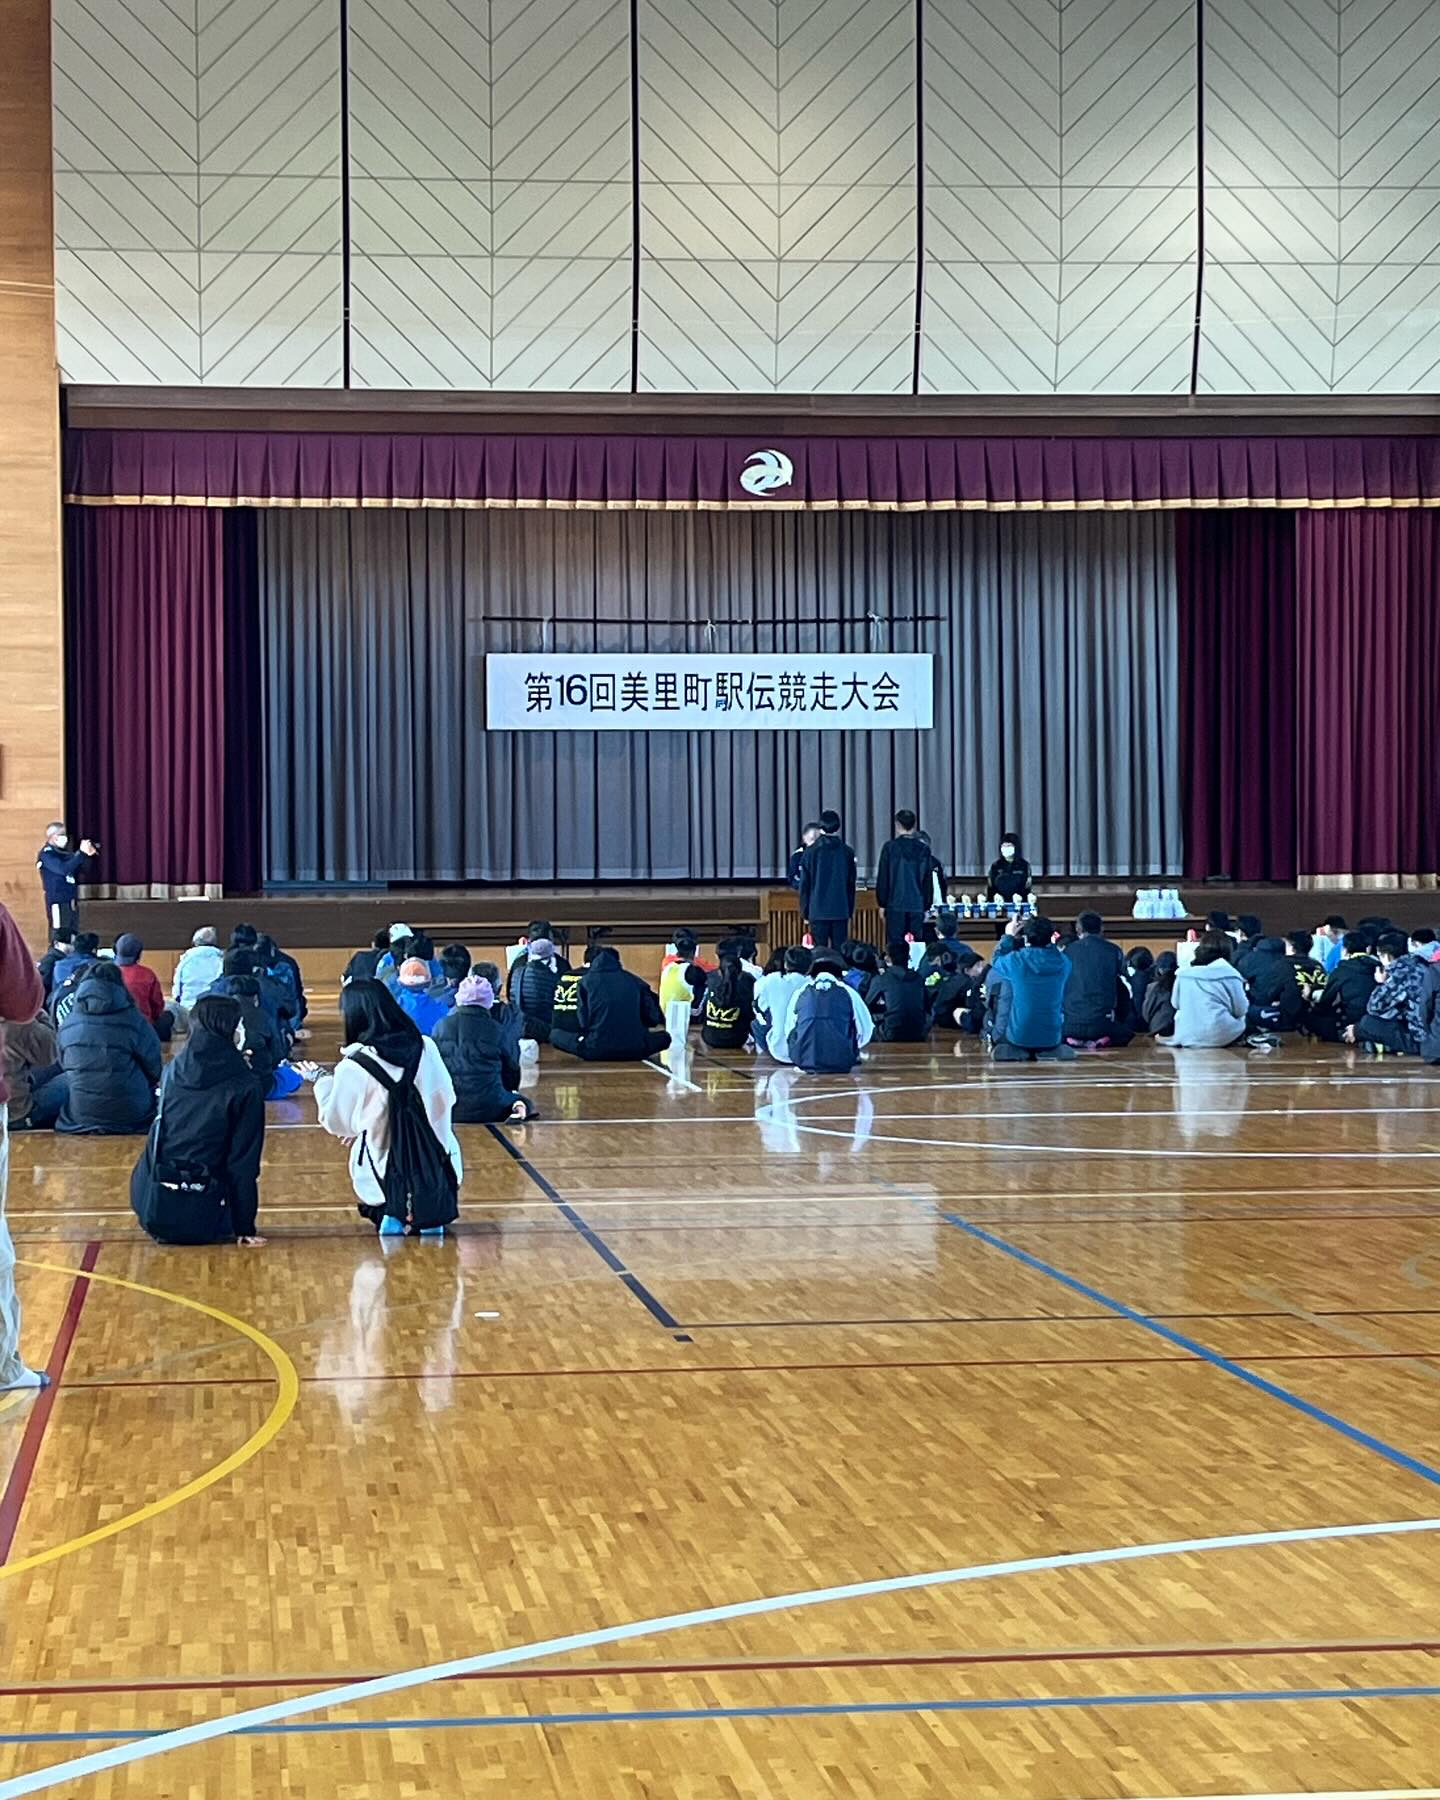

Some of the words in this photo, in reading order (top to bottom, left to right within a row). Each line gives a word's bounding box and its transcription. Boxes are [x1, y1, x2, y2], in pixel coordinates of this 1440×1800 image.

[525, 671, 900, 713] 第16回美里町駅伝競走大会
